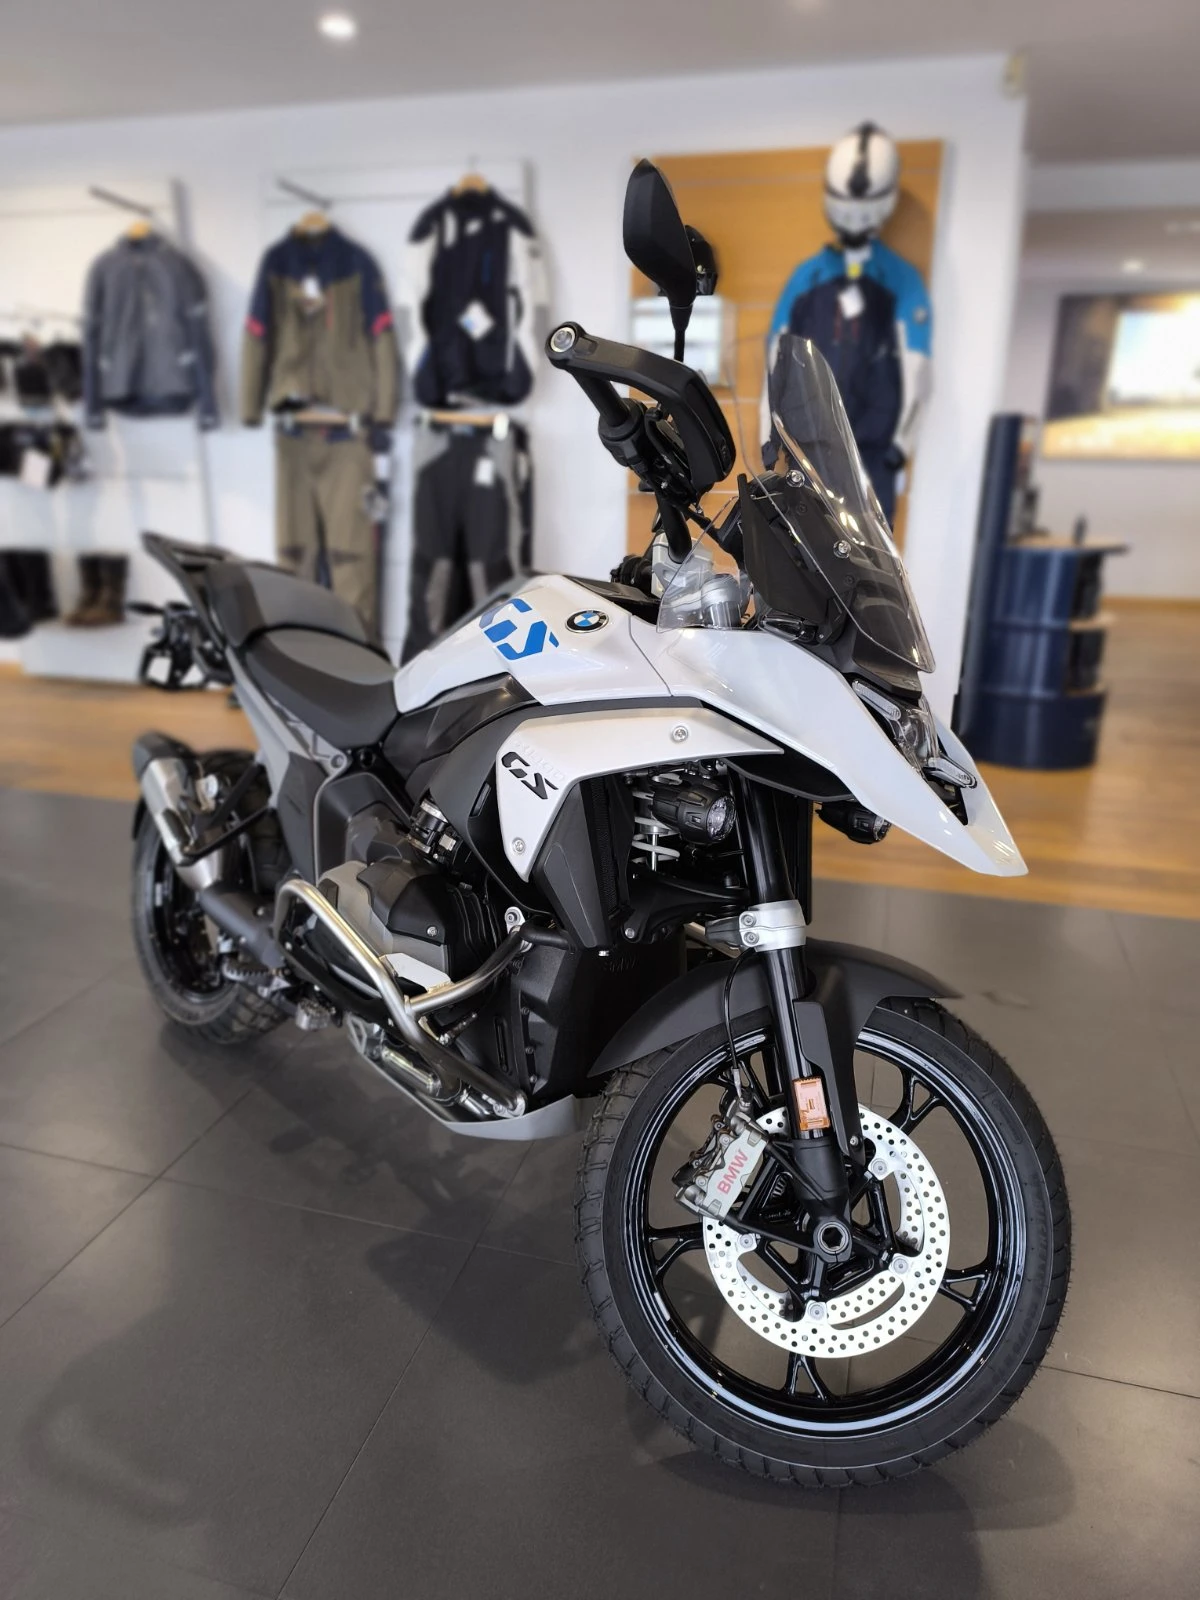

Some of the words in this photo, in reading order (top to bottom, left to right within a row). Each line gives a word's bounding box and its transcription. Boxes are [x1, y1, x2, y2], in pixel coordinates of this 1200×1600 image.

[479, 598, 559, 661] GS
[501, 751, 559, 800] GS
[717, 1149, 748, 1195] BMW
